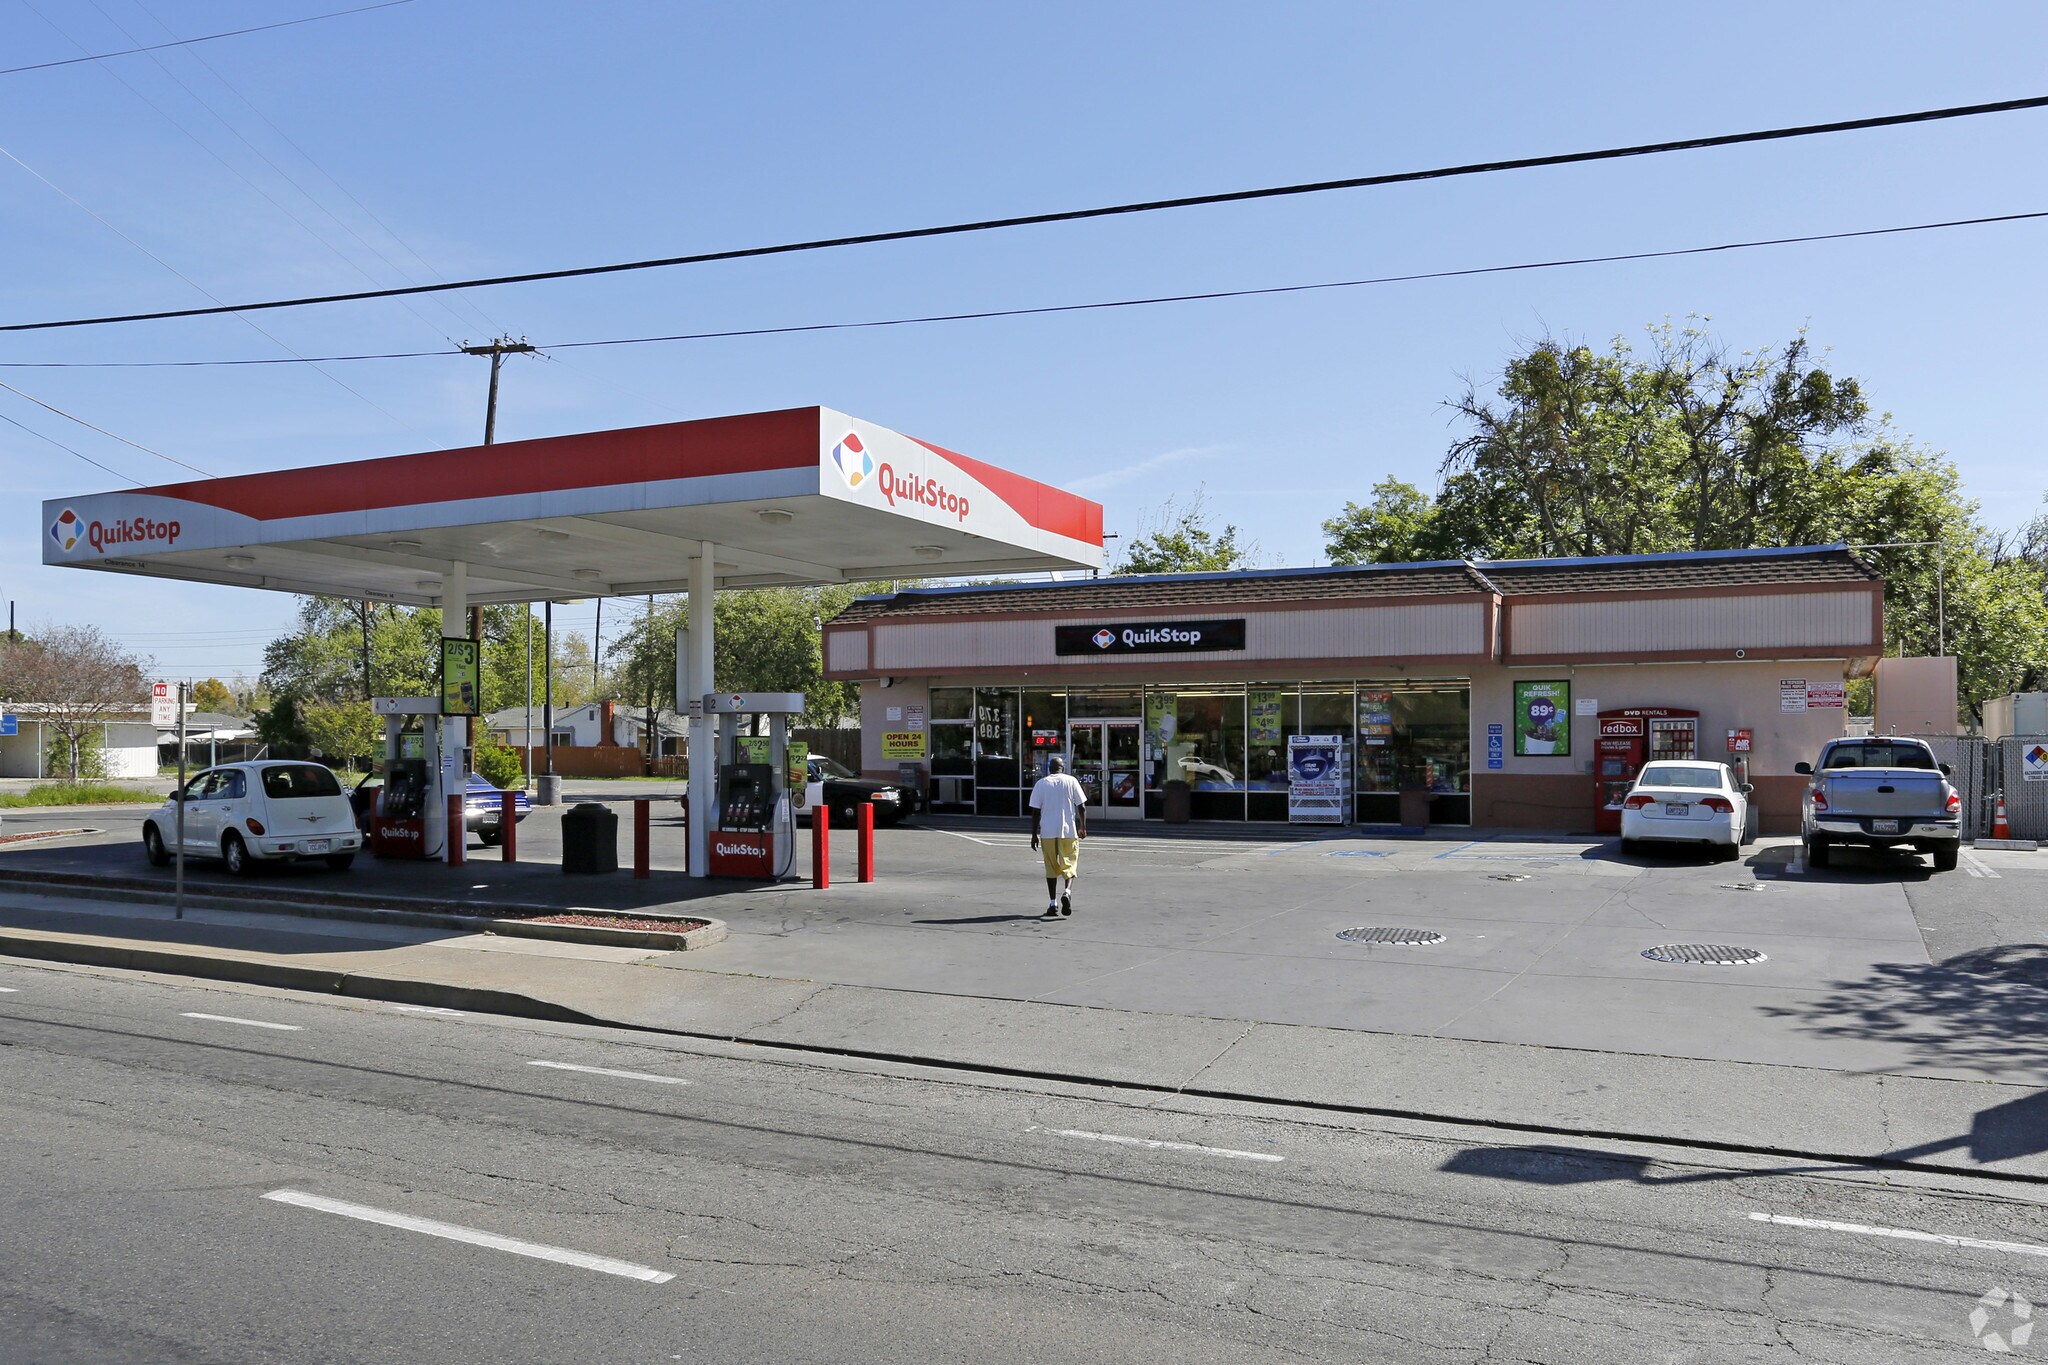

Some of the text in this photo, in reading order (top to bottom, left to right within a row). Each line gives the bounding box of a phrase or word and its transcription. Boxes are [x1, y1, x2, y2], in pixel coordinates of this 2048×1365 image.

[878, 462, 970, 523] QuikStop
[88, 517, 181, 554] QuikStop
[104, 558, 136, 567] Clearance
[1122, 628, 1201, 648] QuikStop
[155, 686, 166, 695] NO
[710, 699, 716, 709] 2
[1530, 705, 1554, 717] 89¢
[1602, 724, 1638, 733] redbox
[1736, 739, 1750, 747] AIR
[381, 826, 419, 840] QuikStop
[716, 843, 767, 859] QuikStop
